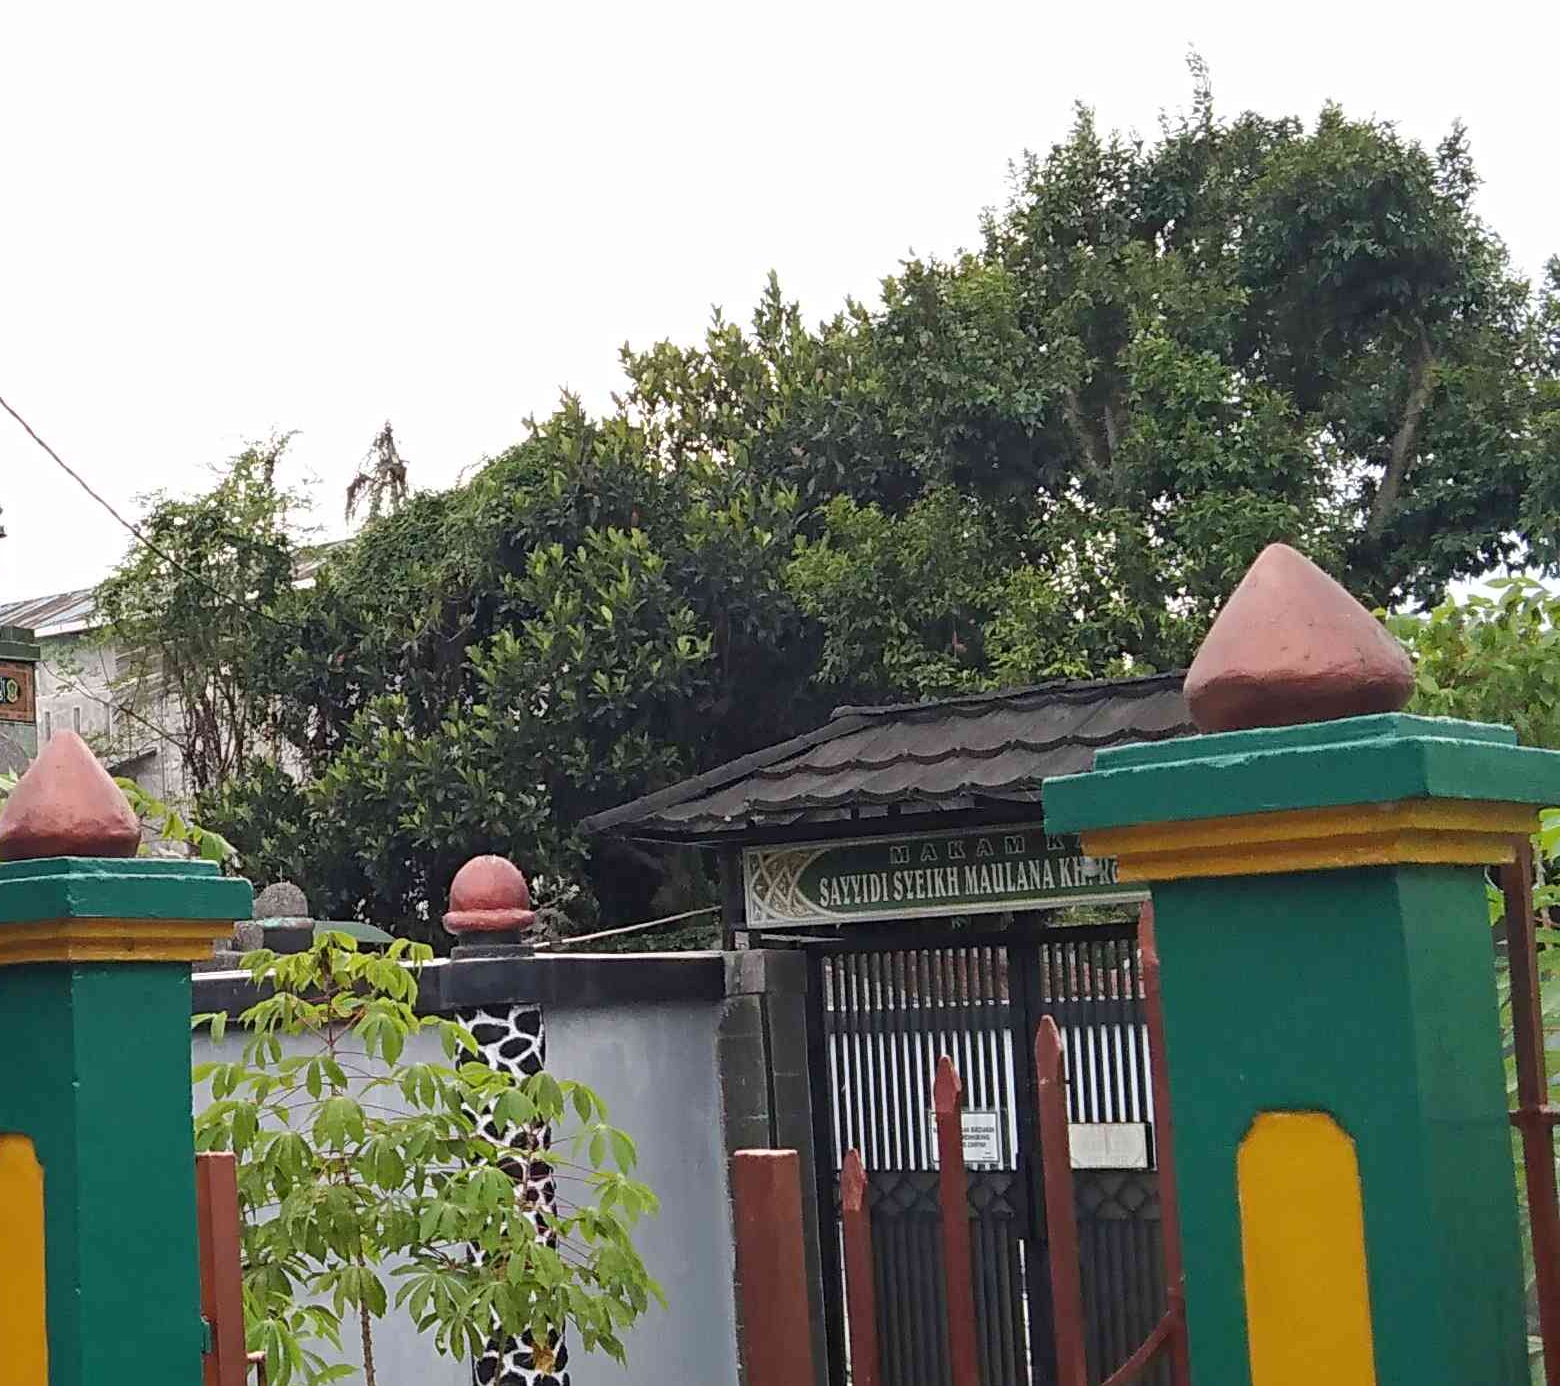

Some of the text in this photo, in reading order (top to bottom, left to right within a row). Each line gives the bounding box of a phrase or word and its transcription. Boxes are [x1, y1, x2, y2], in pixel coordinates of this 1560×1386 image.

[890, 834, 1025, 864] MAKAM
[819, 871, 889, 907] SAYYIDI
[893, 866, 960, 901] SYEIKH
[964, 858, 1056, 895] MAULANA
